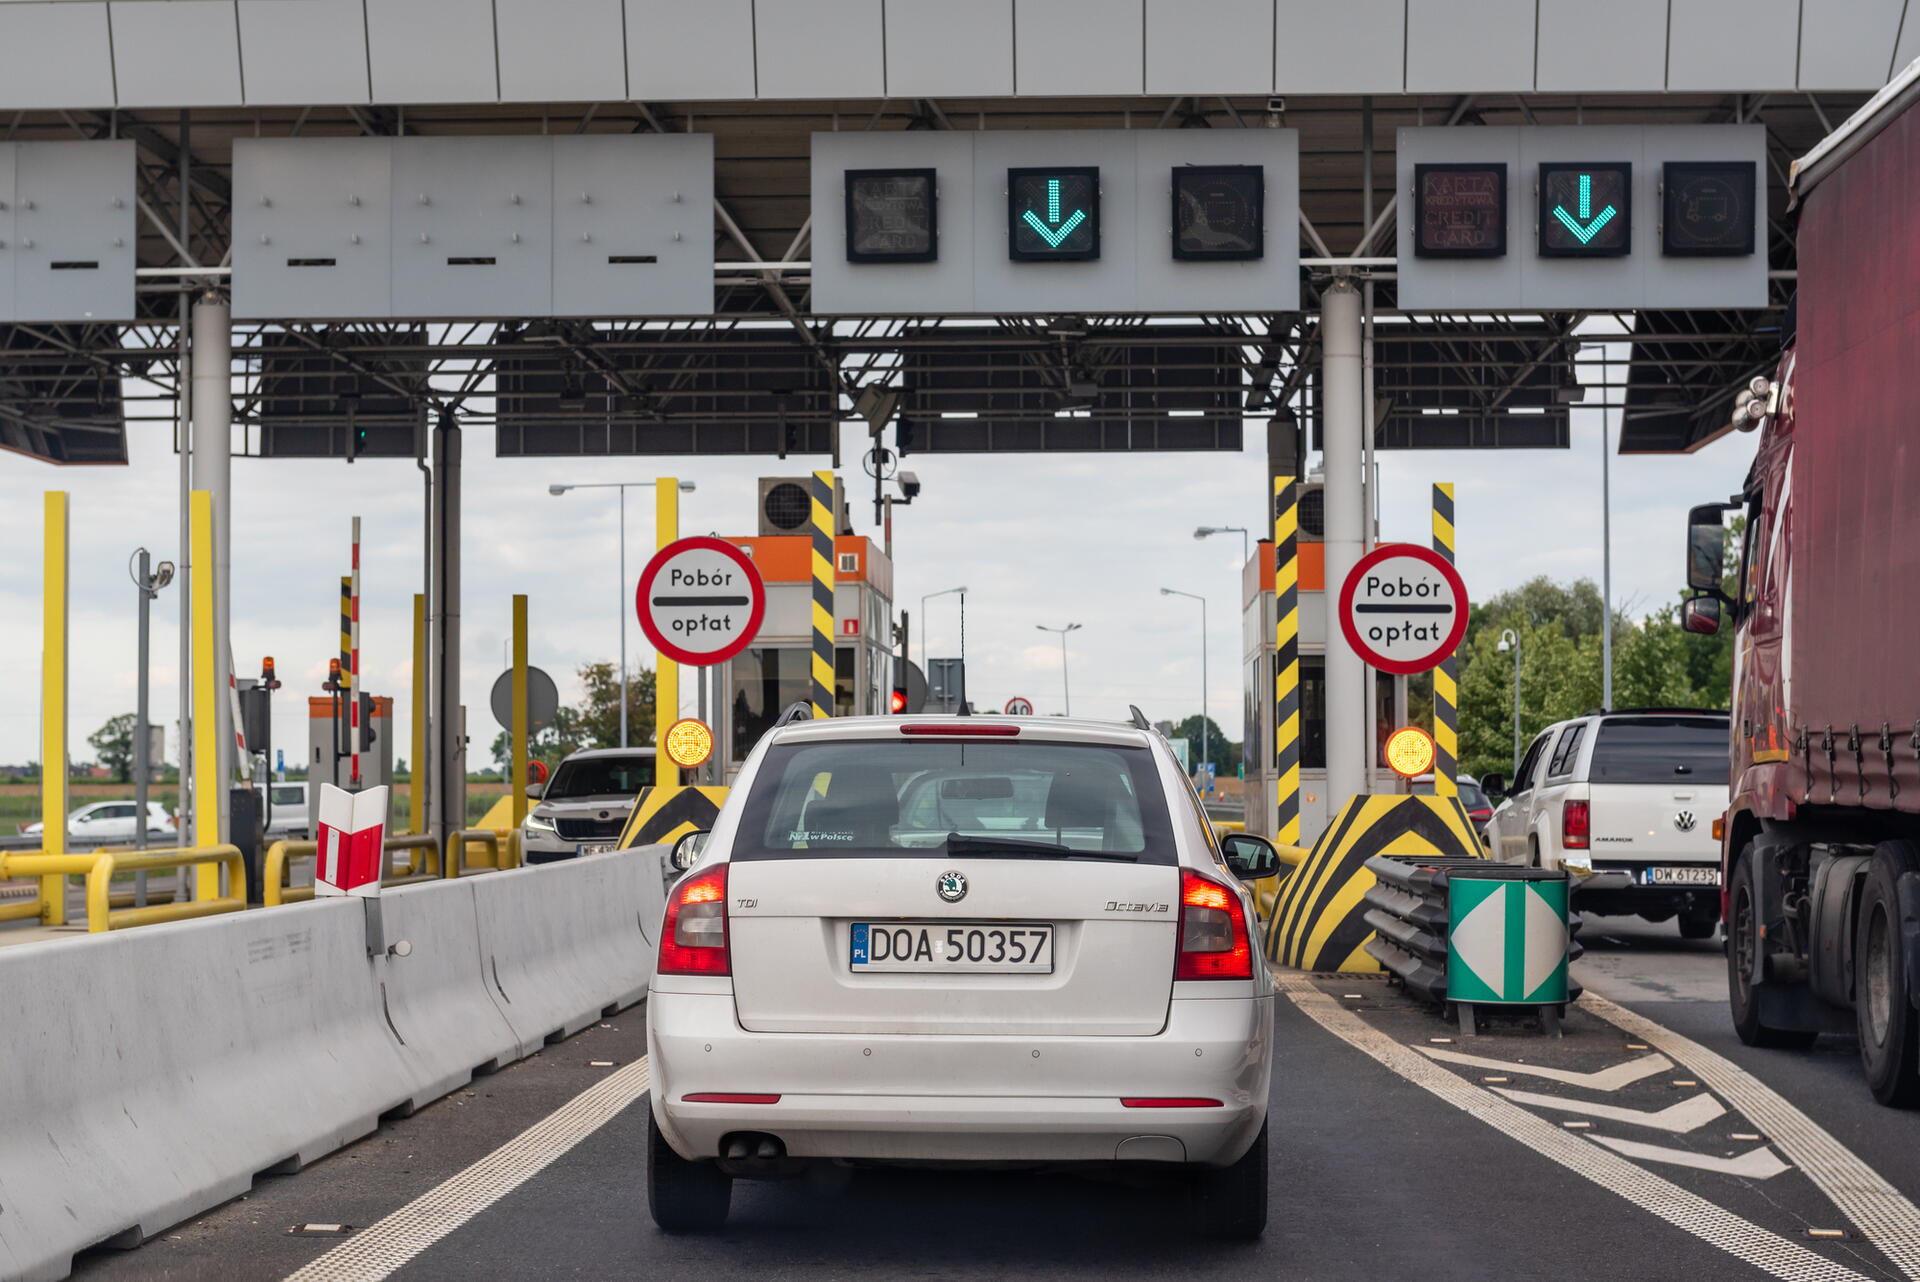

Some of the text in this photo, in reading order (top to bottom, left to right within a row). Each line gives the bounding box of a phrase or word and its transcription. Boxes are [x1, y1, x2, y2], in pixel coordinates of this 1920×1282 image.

[1423, 176, 1495, 193] KARTA
[1424, 211, 1495, 225] CREDIT
[1434, 230, 1487, 246] CARD
[671, 568, 732, 587] Pobór
[1367, 576, 1440, 598] Pobór
[672, 613, 731, 637] opłat
[1368, 620, 1439, 647] opłat
[820, 833, 854, 841] Polsce
[1655, 868, 1715, 881] DW 6T235
[737, 899, 759, 908] TDI
[1104, 900, 1169, 912] Octavia
[854, 949, 866, 958] PL
[871, 928, 1048, 963] DOA 50357
